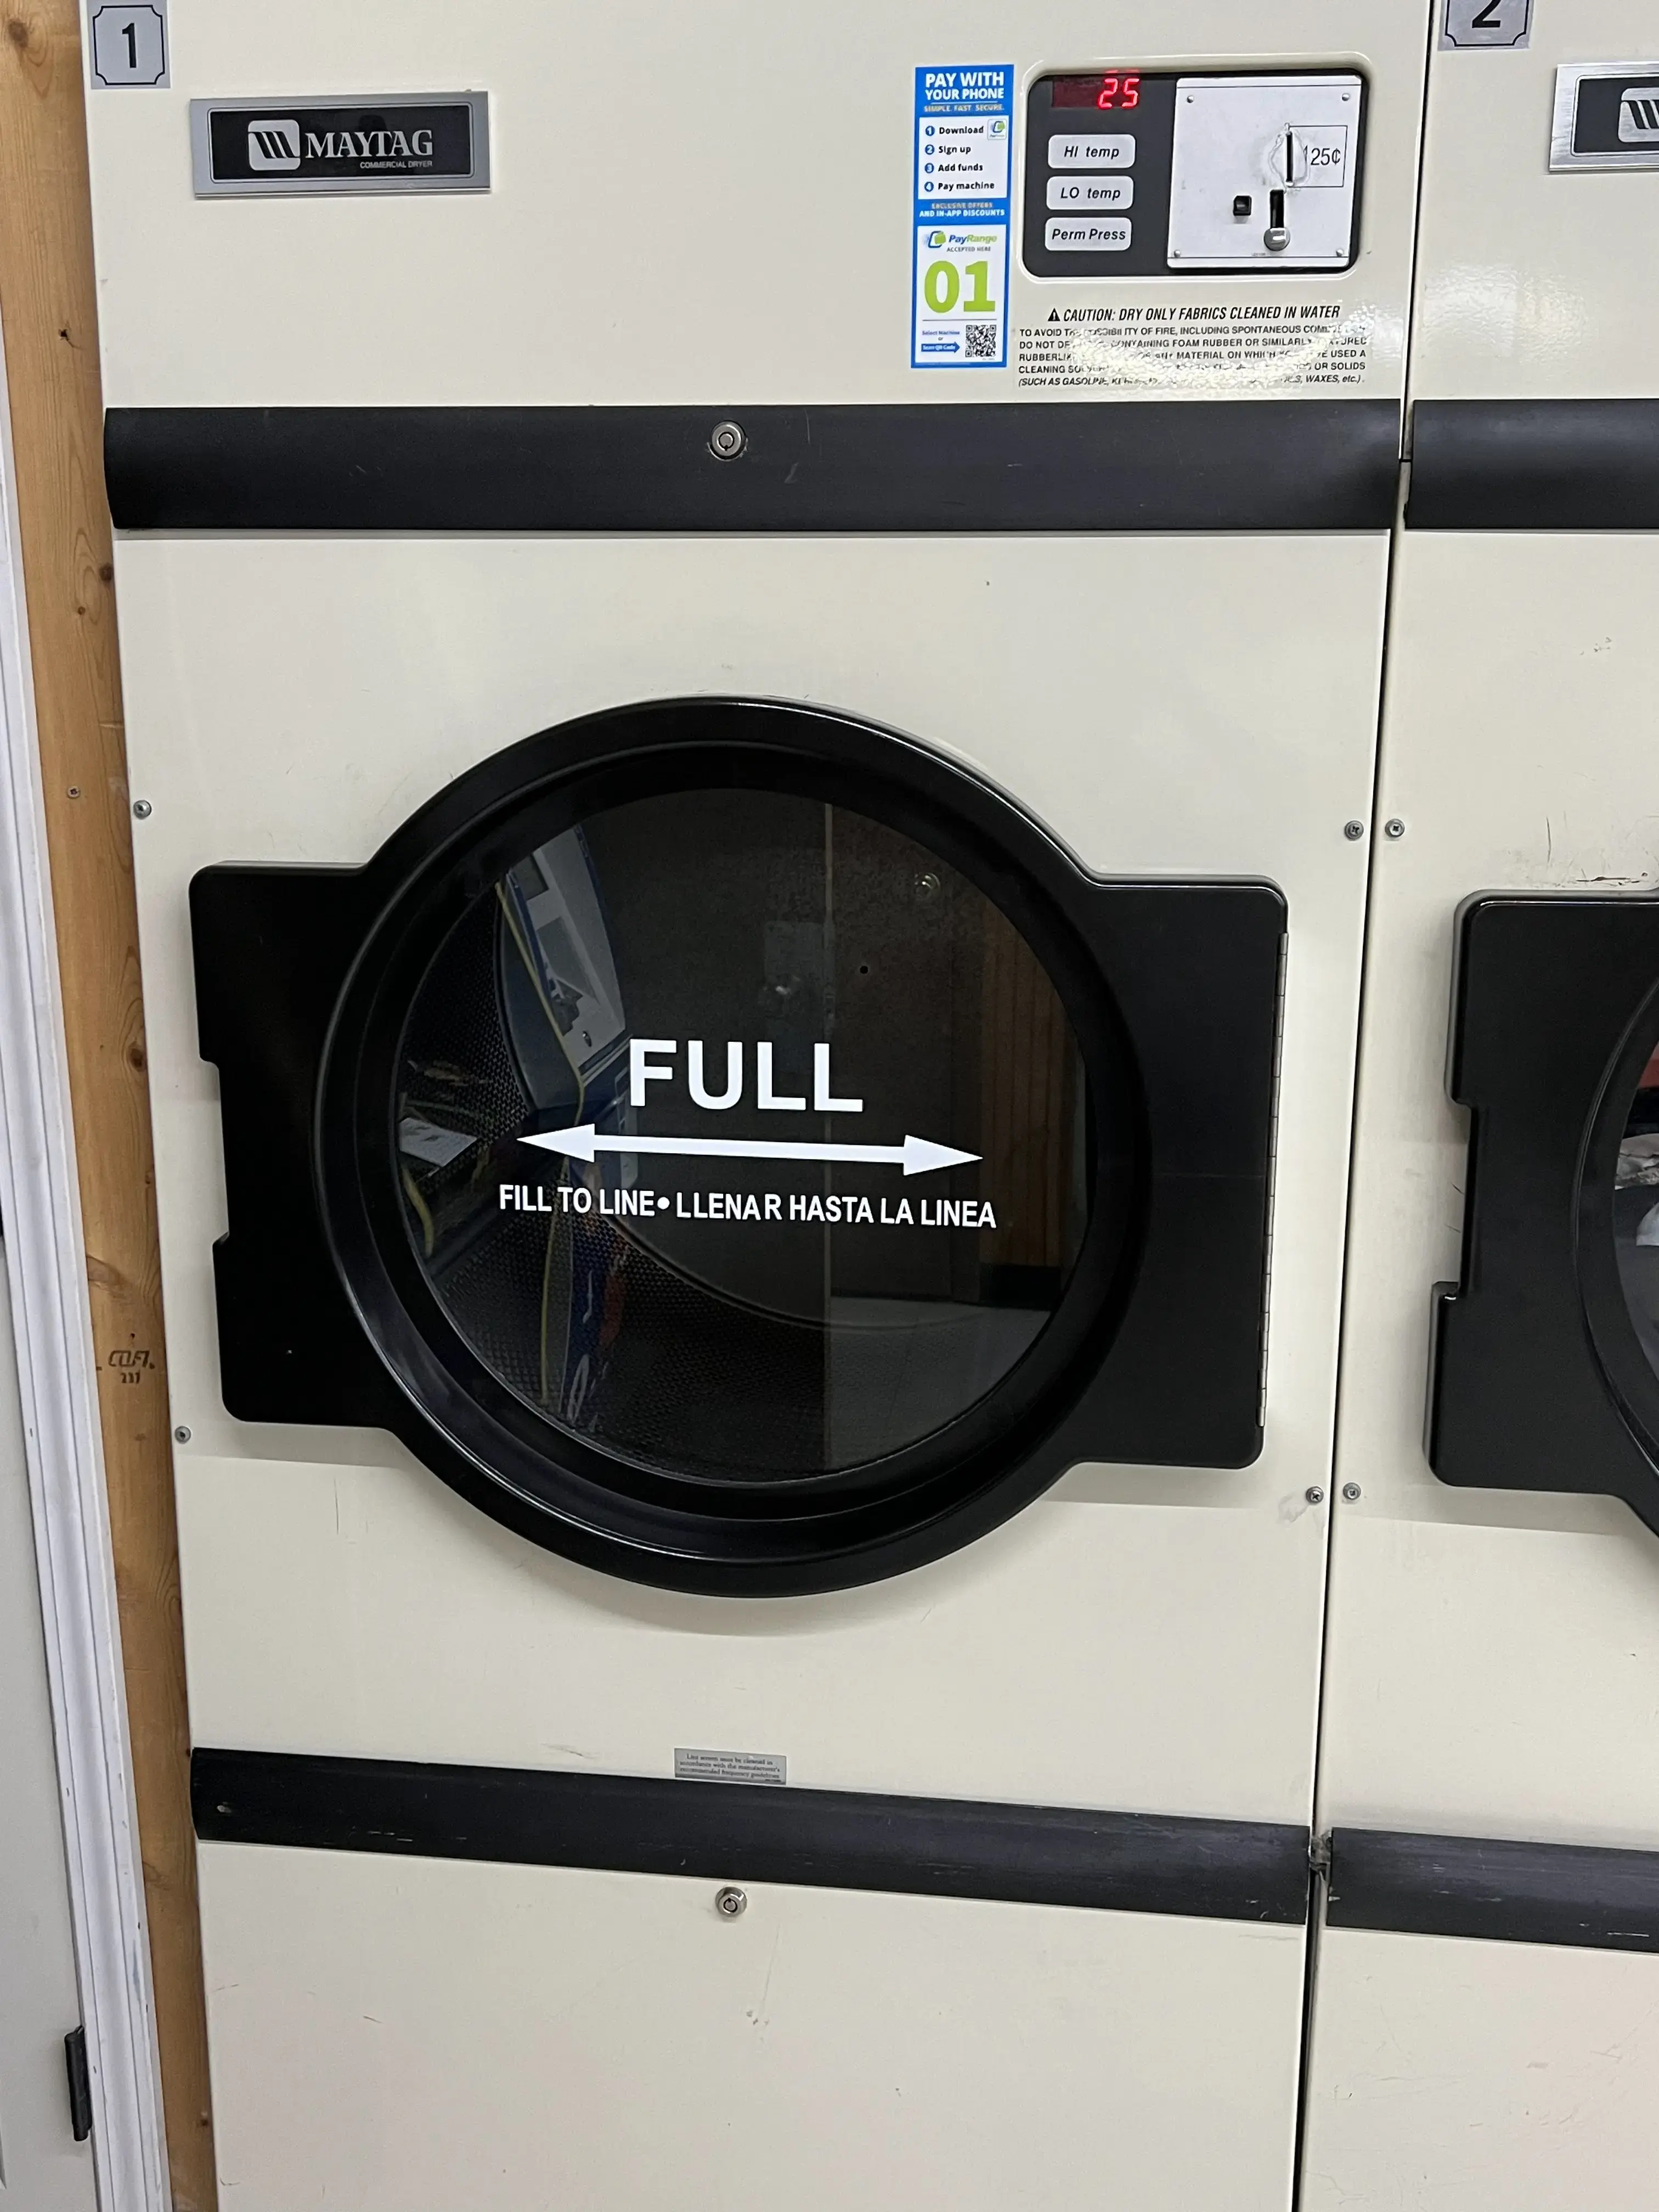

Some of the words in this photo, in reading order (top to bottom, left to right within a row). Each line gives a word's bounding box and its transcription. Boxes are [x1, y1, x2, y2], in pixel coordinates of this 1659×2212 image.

[1472, 0, 1502, 29] 2
[122, 22, 137, 68] 1
[925, 72, 957, 88] PAY
[961, 71, 1005, 87] WITH
[925, 88, 960, 100] YOUR
[962, 87, 1005, 99] PHONE
[1098, 78, 1139, 108] 25
[939, 126, 984, 134] Download
[305, 129, 433, 159] MAYTAG
[938, 145, 957, 155] Sign
[1064, 146, 1078, 157] HI
[1086, 146, 1120, 159] temp
[360, 161, 407, 169] COMMERCIAL
[938, 163, 956, 172] Add
[958, 163, 983, 171] funds
[938, 182, 953, 191] Pay
[956, 181, 995, 189] machine
[1060, 187, 1080, 199] LO
[1087, 188, 1121, 201] temp
[949, 234, 997, 245] PayRange
[1052, 228, 1086, 240] Perm
[1089, 228, 1126, 240] Press
[924, 260, 995, 313] 01
[1063, 308, 1116, 321] CAUTION:
[1119, 308, 1143, 321] DRY
[1146, 307, 1176, 320] ONLY
[1178, 307, 1227, 320] FABRICS
[1230, 306, 1281, 319] CLEANED
[1284, 306, 1297, 319] IN
[1300, 305, 1340, 319] WATER
[1141, 327, 1153, 335] OF
[1155, 326, 1178, 336] FIRE,
[1180, 326, 1229, 335] INCLUDING
[1232, 325, 1301, 334] SPONTANEOUS
[1036, 341, 1055, 349] NOT
[1172, 339, 1200, 347] FOAM
[1203, 338, 1242, 347] RUBBER
[1245, 338, 1259, 346] OR
[1176, 351, 1224, 359] MATERIAL
[1227, 351, 1242, 359] ON
[1314, 362, 1328, 370] OR
[1330, 362, 1365, 370] SOLIDS
[1018, 377, 1047, 387] (SUCH
[1048, 377, 1060, 386] AS
[1306, 375, 1340, 383] WAXES,
[629, 1038, 864, 1113] FULL
[499, 1183, 552, 1212] FILL
[557, 1186, 592, 1214] TO
[676, 1192, 782, 1221] LLENAR
[789, 1194, 874, 1223] HASTA
[880, 1198, 914, 1225] LA
[921, 1199, 997, 1228] LINEA
